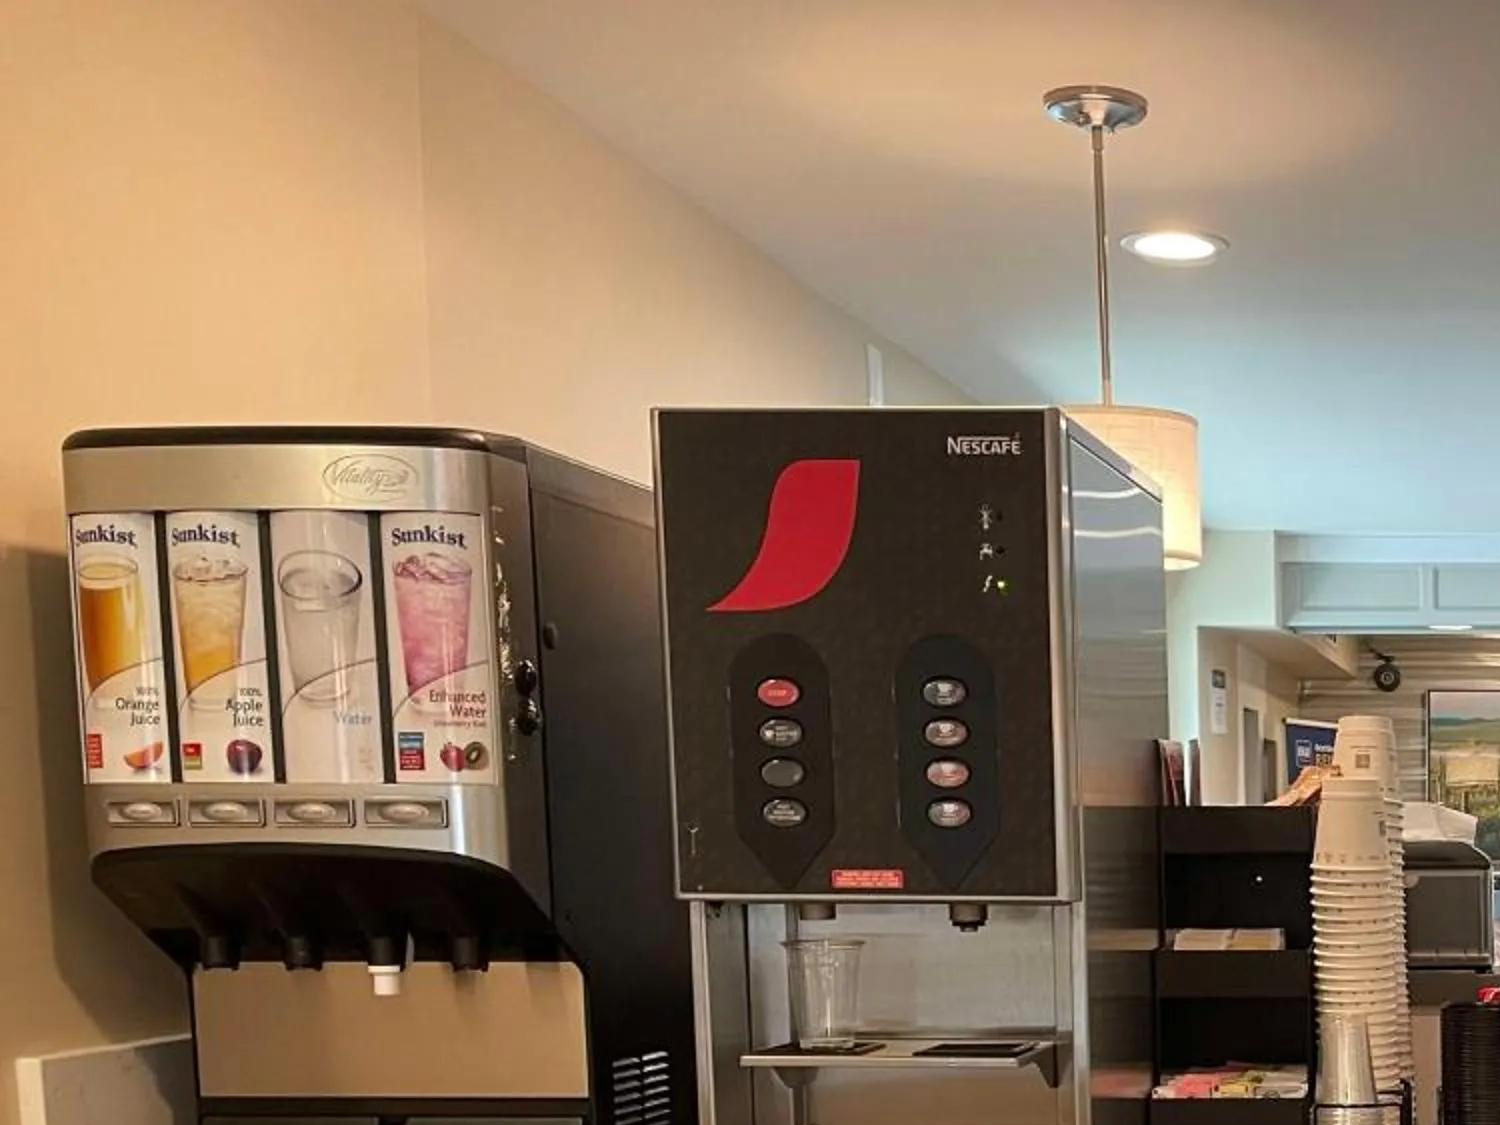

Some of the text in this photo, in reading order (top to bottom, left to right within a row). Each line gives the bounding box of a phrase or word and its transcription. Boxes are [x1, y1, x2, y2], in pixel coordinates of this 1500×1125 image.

[75, 523, 139, 549] Sunkist
[171, 523, 241, 549] Sunkist
[391, 525, 467, 550] Sunkist
[429, 689, 486, 703] Enhanced
[115, 697, 160, 713] Orange
[225, 698, 264, 713] Apple
[450, 703, 487, 719] Water
[130, 712, 161, 726] Juice
[232, 712, 264, 727] Juice
[333, 710, 373, 726] Water
